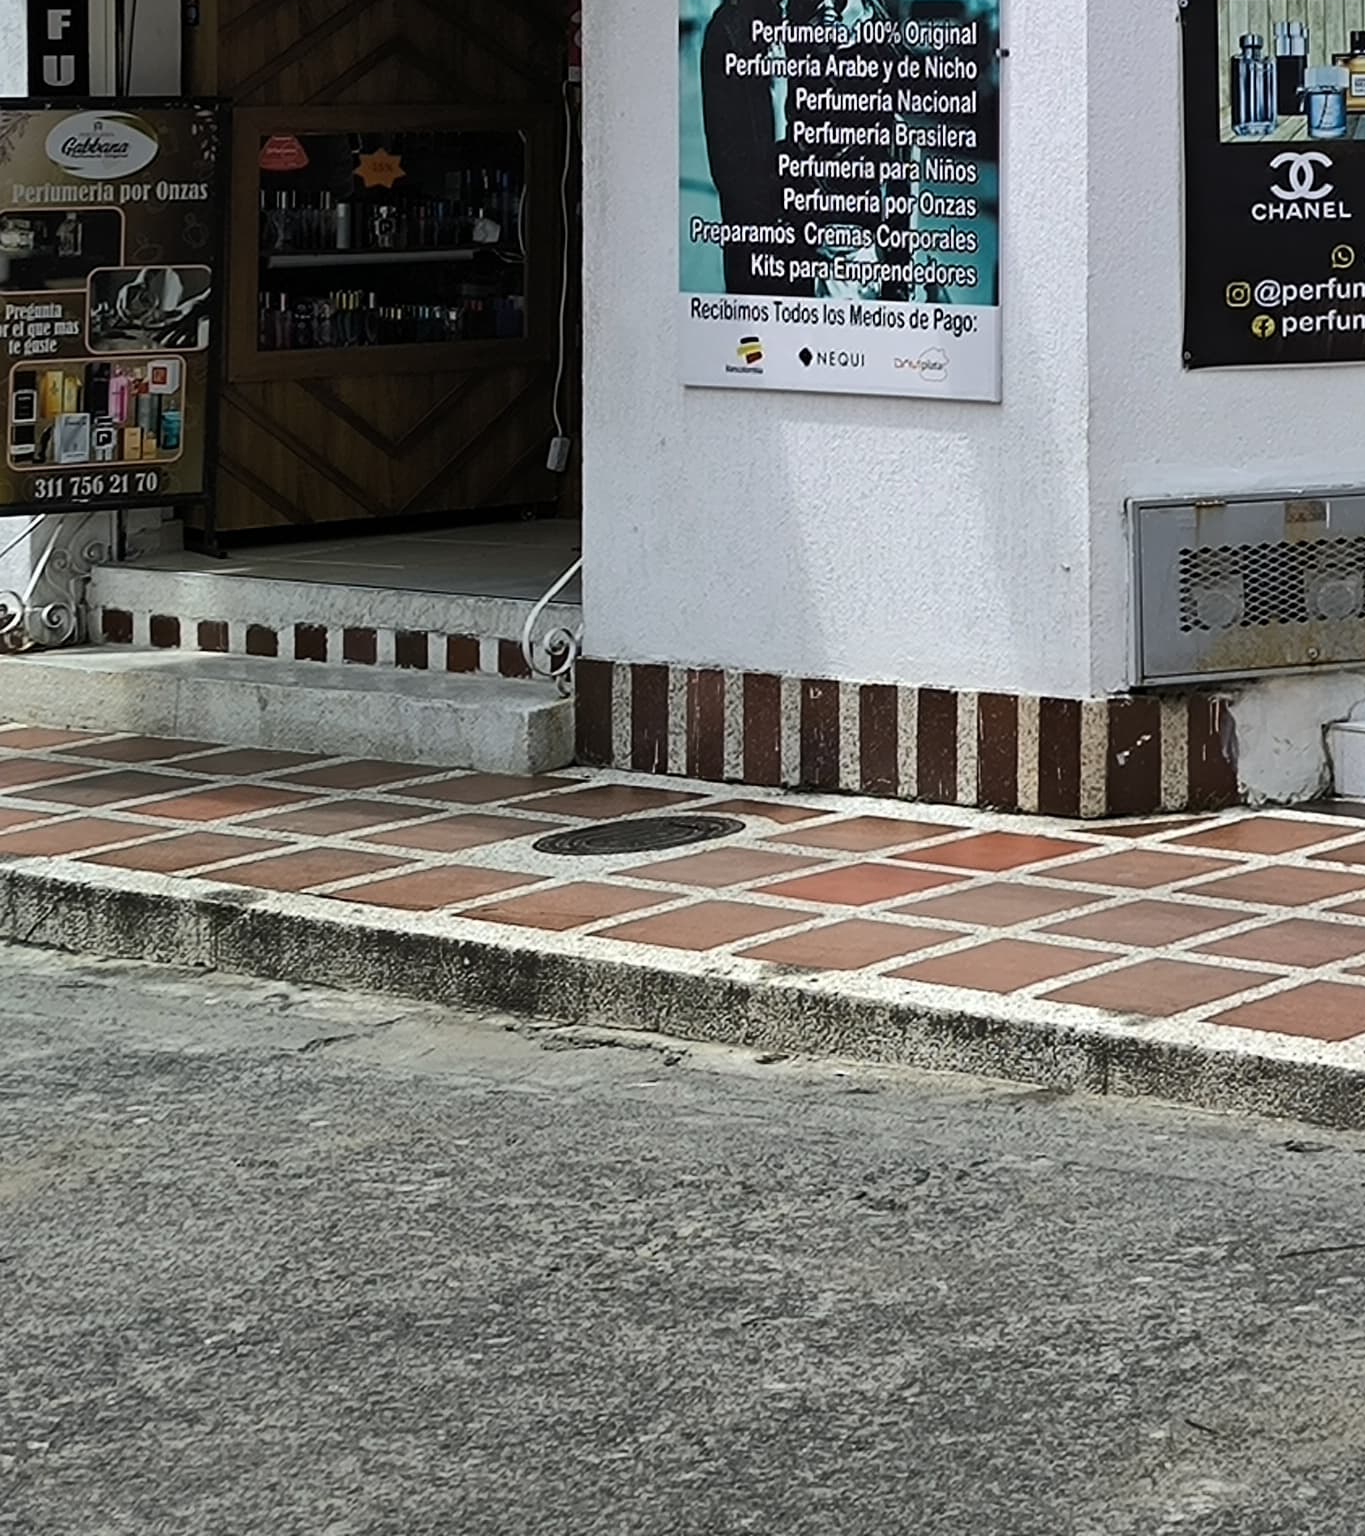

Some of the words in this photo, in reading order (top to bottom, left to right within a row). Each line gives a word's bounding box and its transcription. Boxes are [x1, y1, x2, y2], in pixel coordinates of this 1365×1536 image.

[854, 21, 901, 45] 100%
[905, 21, 978, 50] Original
[825, 55, 879, 78] Arabe
[882, 61, 893, 84] y
[897, 56, 920, 78] de
[925, 55, 978, 79] Nicho
[796, 87, 893, 112] Perfumería
[897, 89, 977, 114] Nacional
[793, 120, 890, 146] Perfumería
[896, 122, 977, 148] Brasilera
[778, 153, 875, 179] Perfumería
[879, 161, 919, 184] para
[925, 157, 977, 182] Niños
[119, 184, 151, 204] por
[156, 180, 208, 200] Onzas
[783, 187, 880, 213] Perfumería
[885, 196, 915, 220] por
[919, 191, 977, 216] Onzas
[1251, 203, 1352, 221] CHANEL
[691, 219, 796, 246] Preparamos
[804, 221, 873, 247] Cremas
[876, 224, 977, 254] Corporales
[751, 253, 785, 278] Kits
[789, 261, 829, 283] para
[834, 257, 977, 285] Emprendedores
[12, 321, 24, 338] el
[27, 322, 51, 339] que
[773, 301, 819, 324] Todos
[823, 304, 845, 326] los
[850, 304, 905, 328] Medios
[909, 308, 929, 330] de
[933, 307, 978, 338] Pago:
[9, 340, 21, 354] te
[24, 338, 57, 355] guste
[816, 351, 865, 367] NEQUI
[35, 477, 63, 498] 311
[69, 474, 104, 496] 756
[109, 473, 129, 493] 21
[135, 472, 158, 491] 70
